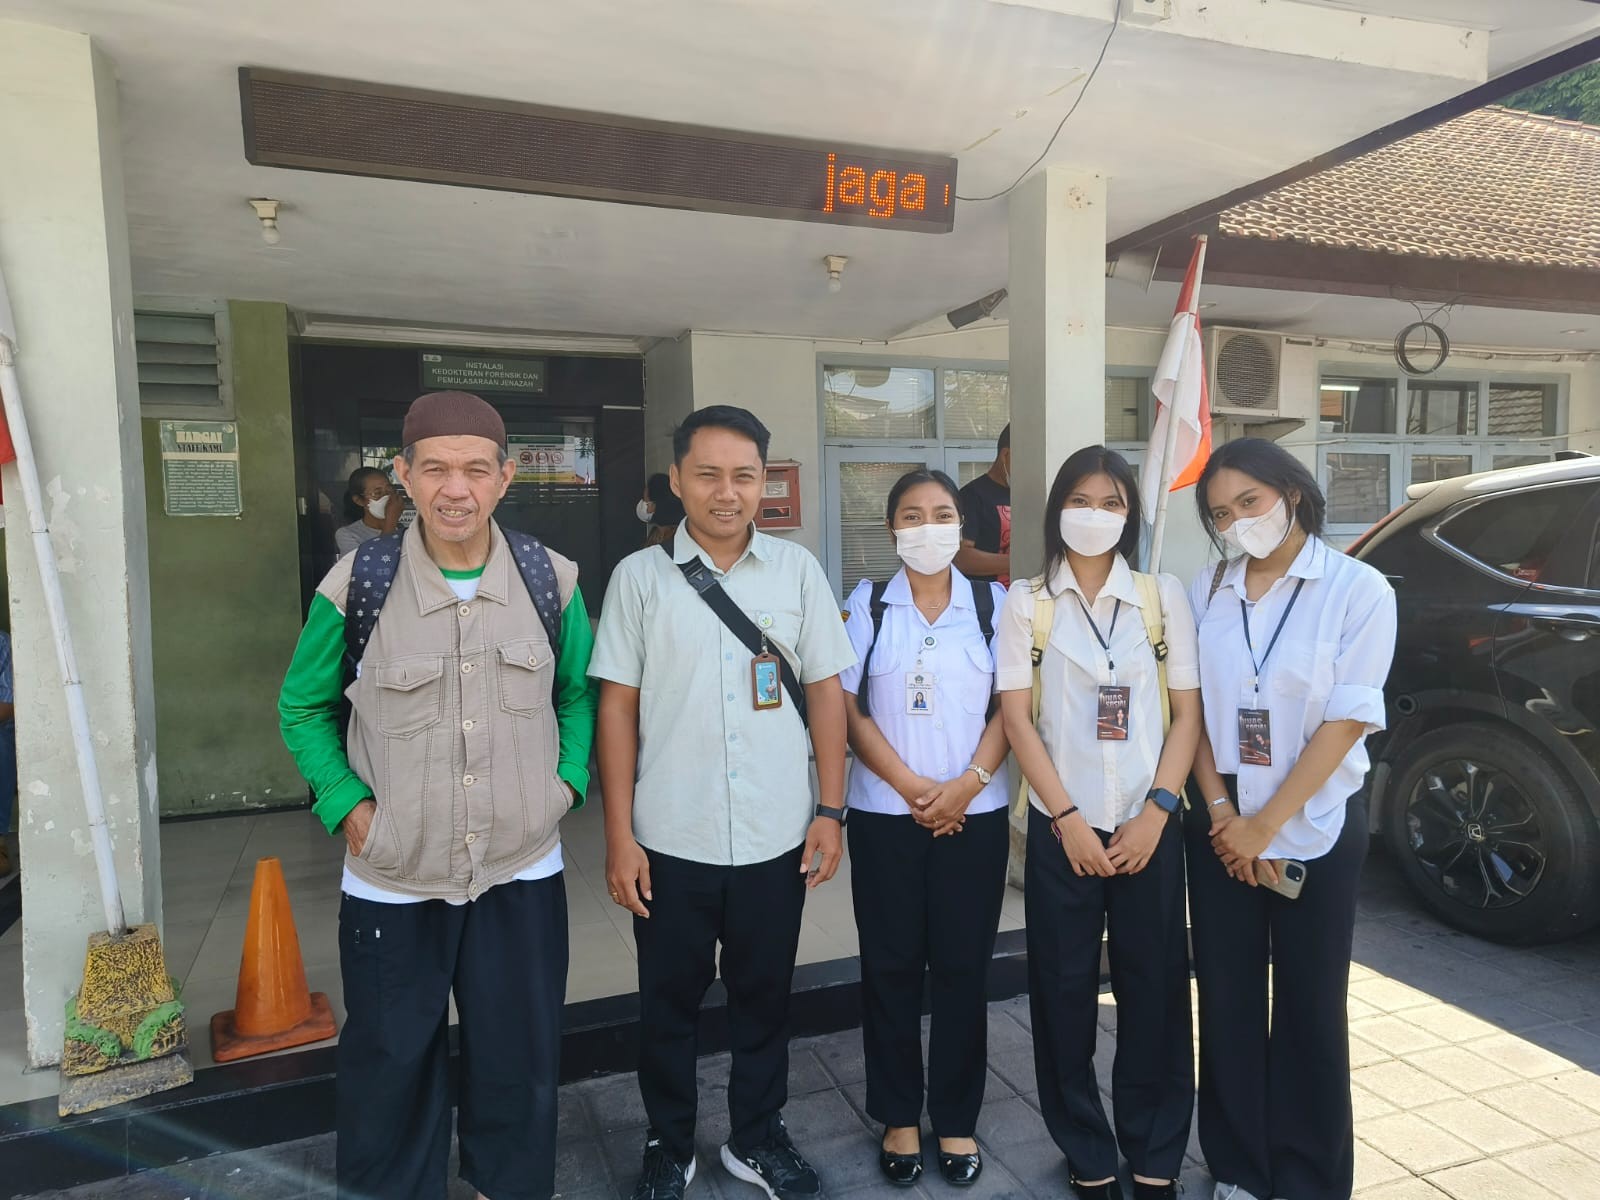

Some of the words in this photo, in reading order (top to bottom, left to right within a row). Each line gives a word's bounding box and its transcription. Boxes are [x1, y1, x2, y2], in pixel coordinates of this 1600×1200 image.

[823, 153, 927, 218] jaga
[465, 362, 504, 370] INSTALASI
[432, 368, 483, 377] KEDOKTERAN
[485, 371, 521, 379] FORENSIK
[437, 376, 499, 385] PEMULASARAAN
